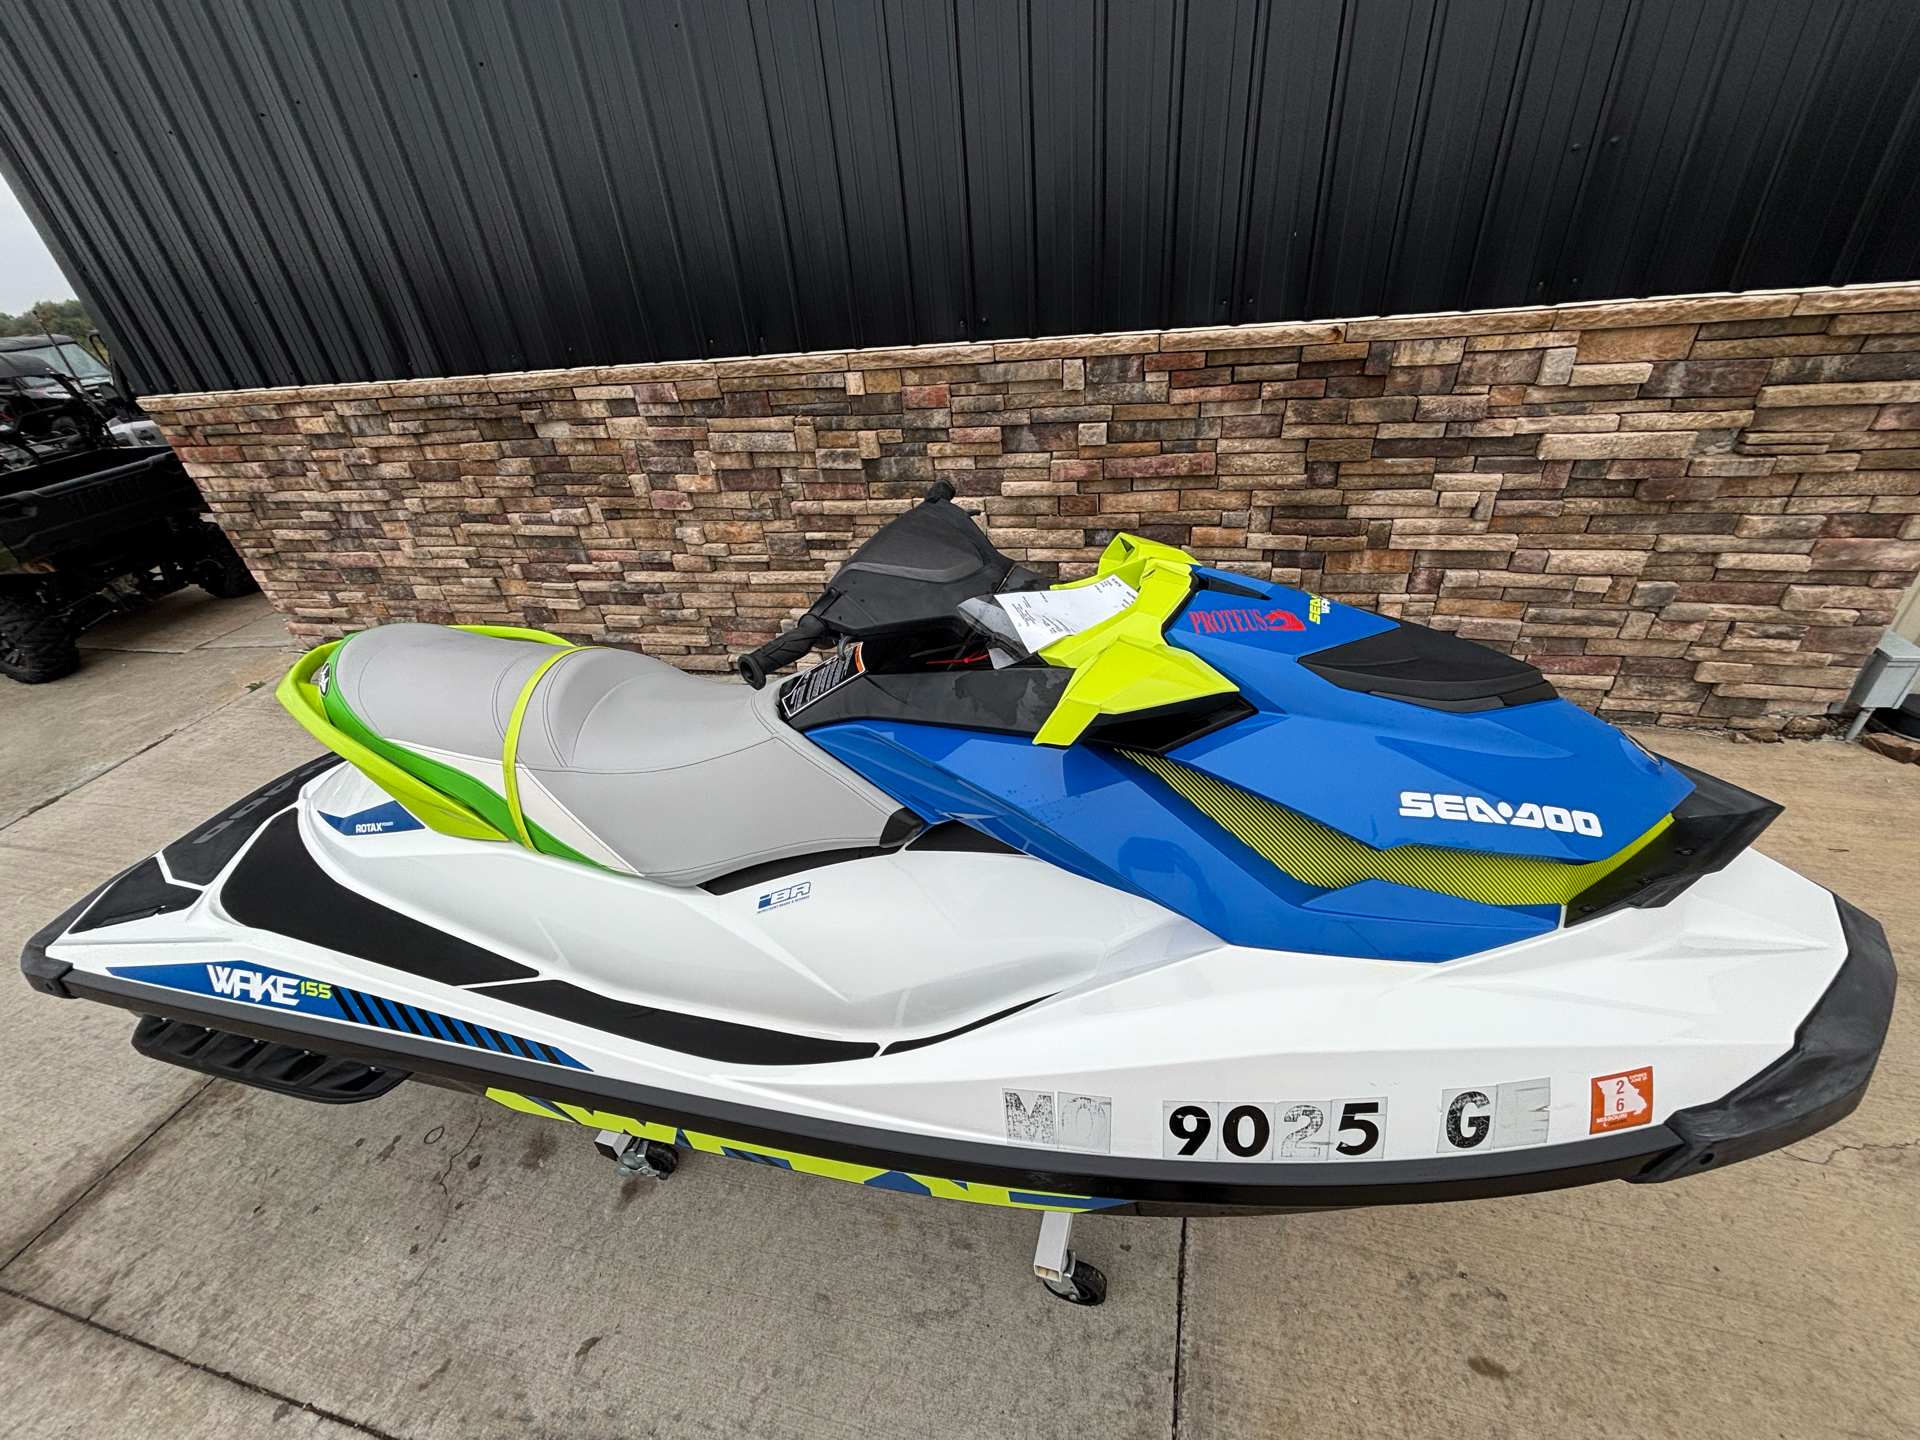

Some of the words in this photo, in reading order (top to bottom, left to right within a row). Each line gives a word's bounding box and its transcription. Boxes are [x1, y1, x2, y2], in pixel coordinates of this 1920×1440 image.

[1188, 609, 1268, 634] PROTEUS
[355, 822, 383, 834] ROTAX
[206, 964, 301, 1007] WAKE
[300, 980, 333, 1000] 155
[1616, 1079, 1625, 1095] 2
[1616, 1097, 1625, 1112] 6
[1596, 1112, 1628, 1124] MISSOURI
[1168, 1101, 1380, 1158] 9025
